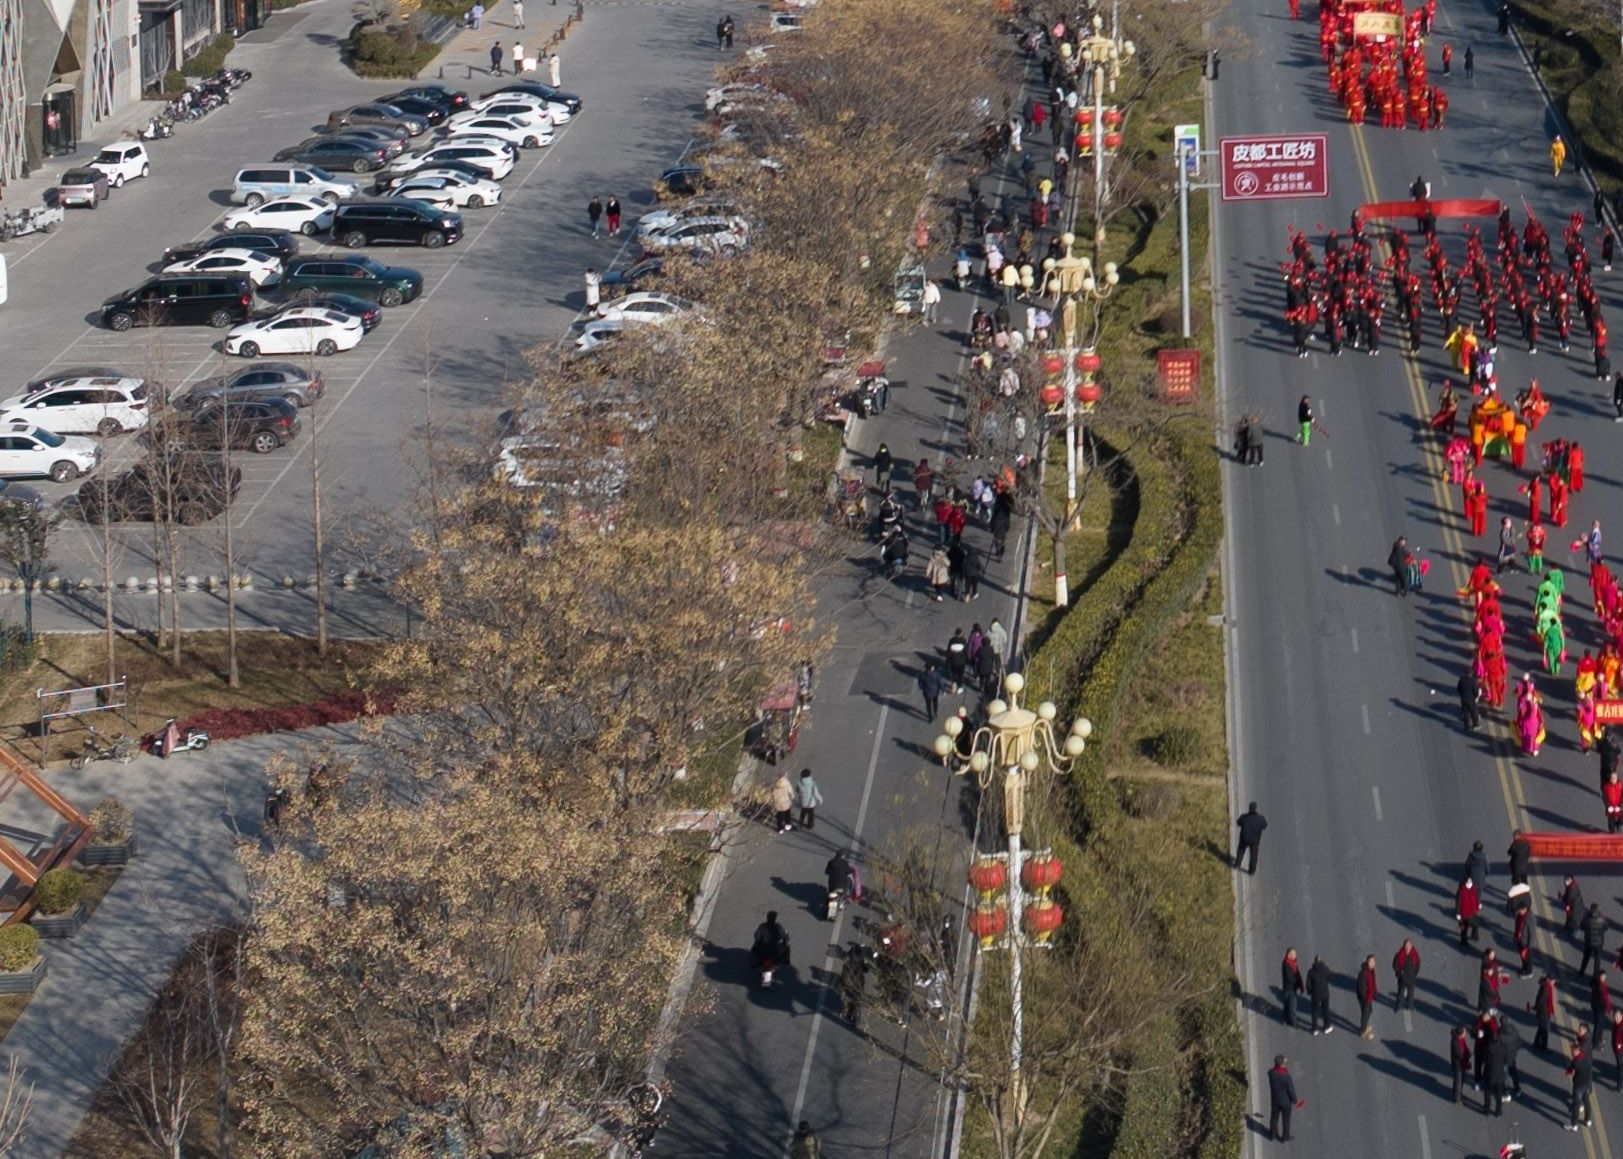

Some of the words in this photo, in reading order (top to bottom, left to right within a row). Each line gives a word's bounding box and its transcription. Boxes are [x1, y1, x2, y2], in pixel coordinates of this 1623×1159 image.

[1232, 141, 1316, 162] 皮都工匠坊
